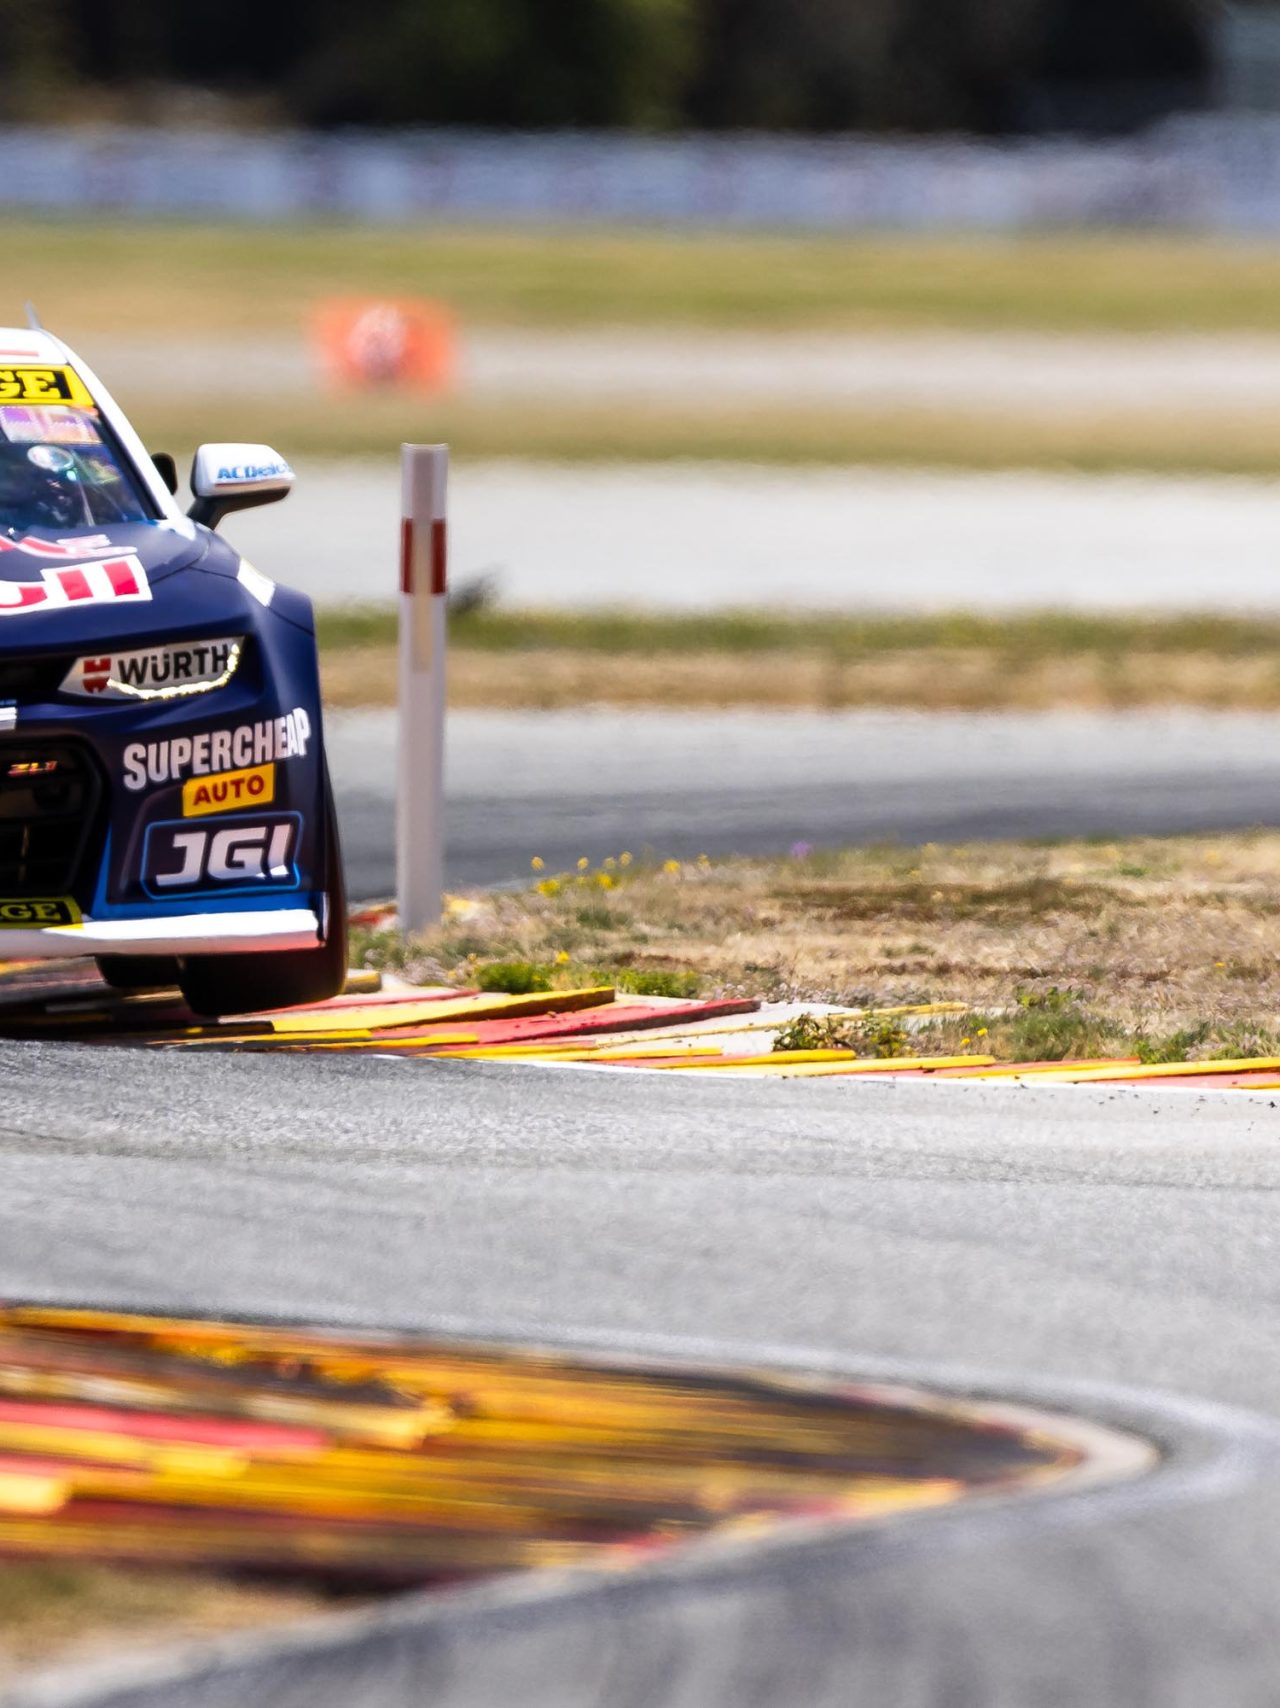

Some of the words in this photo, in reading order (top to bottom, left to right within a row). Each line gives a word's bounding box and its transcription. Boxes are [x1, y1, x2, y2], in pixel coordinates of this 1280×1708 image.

[123, 707, 312, 791] SUPERCHEAP
[193, 774, 265, 805] AUTO
[156, 824, 291, 887] JGI
